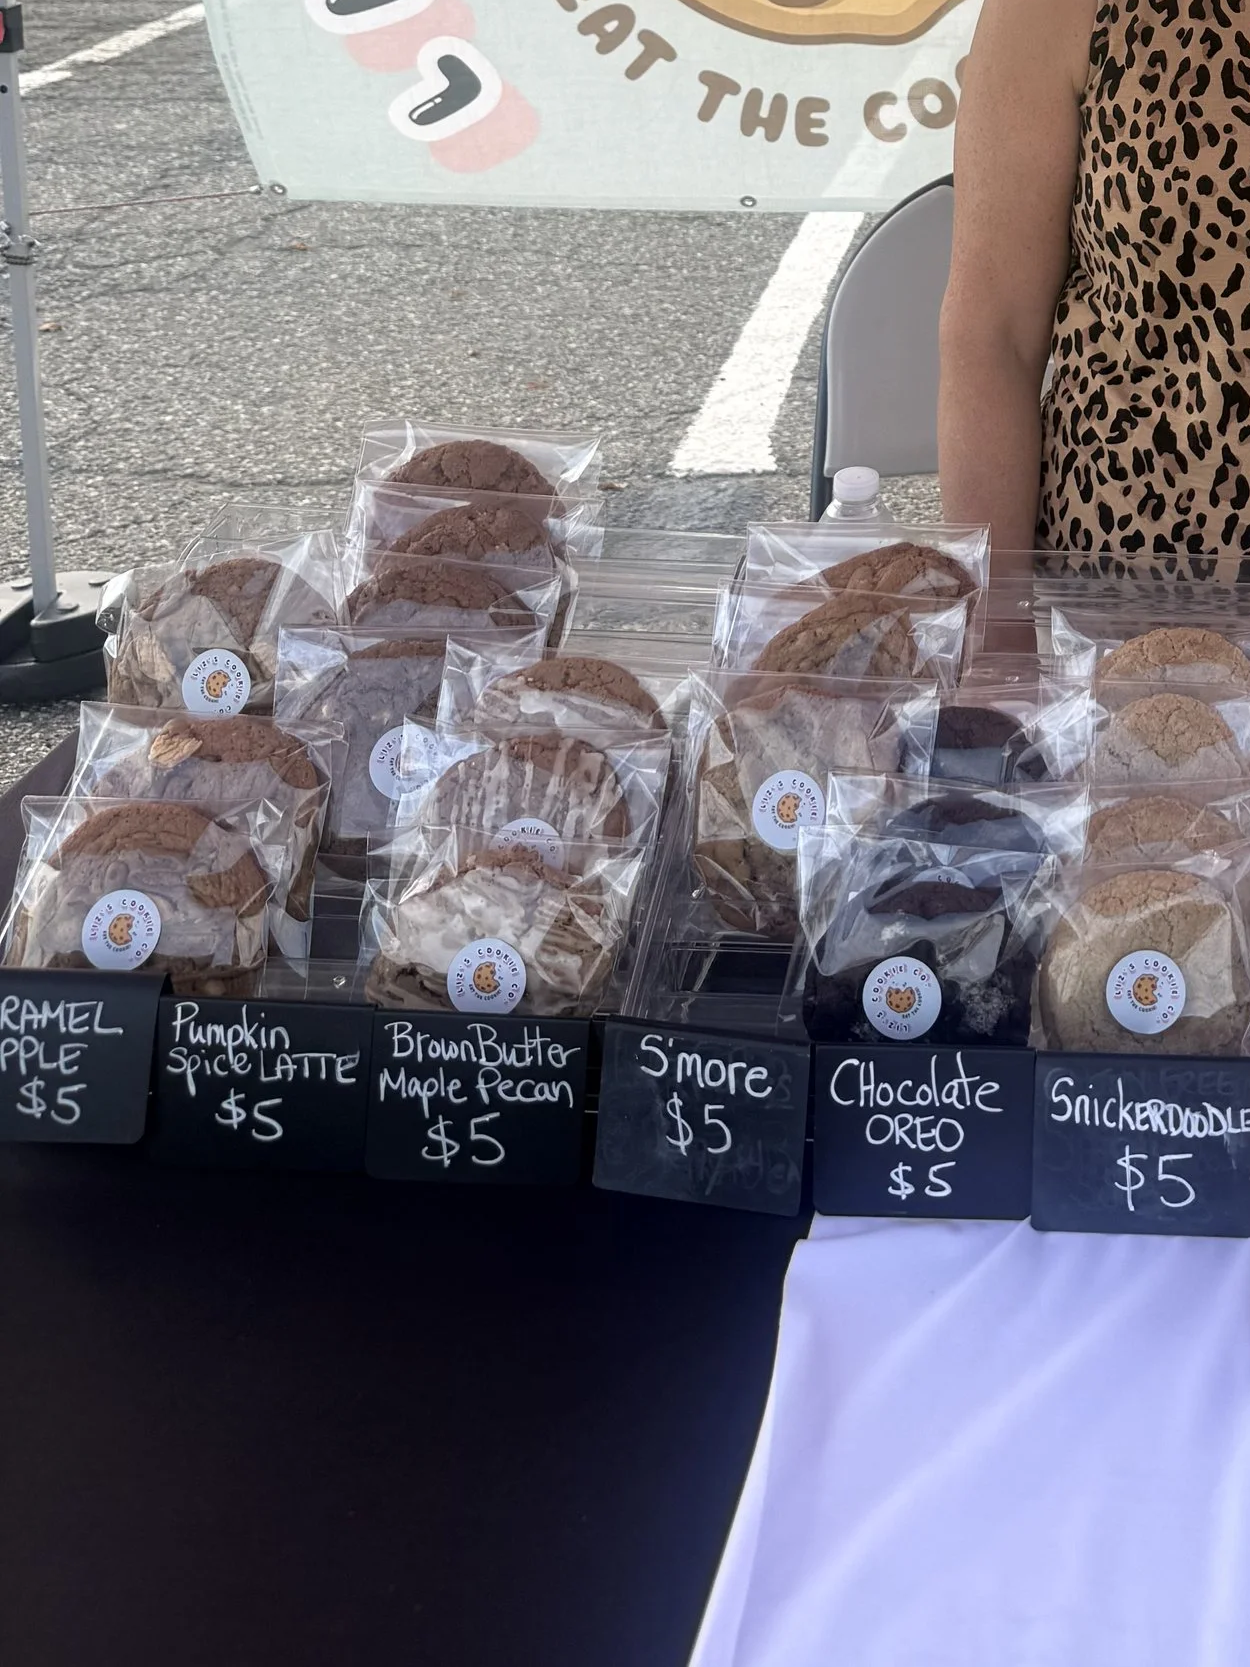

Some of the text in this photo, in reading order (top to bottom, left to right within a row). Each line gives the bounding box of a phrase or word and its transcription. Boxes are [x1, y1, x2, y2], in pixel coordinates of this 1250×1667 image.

[697, 69, 831, 147] THE
[171, 1001, 291, 1065] Pumpkin
[166, 1046, 361, 1097] Spice LATTE
[379, 1066, 574, 1119] Maple Pecan
[640, 1034, 773, 1098] S'more
[16, 1076, 88, 1125] $5
[215, 1088, 283, 1142] $5
[665, 1091, 732, 1157] $5
[421, 1111, 506, 1168] $5
[866, 1113, 965, 1153] OREO
[887, 1161, 957, 1201] $5
[1114, 1144, 1196, 1212] $5
